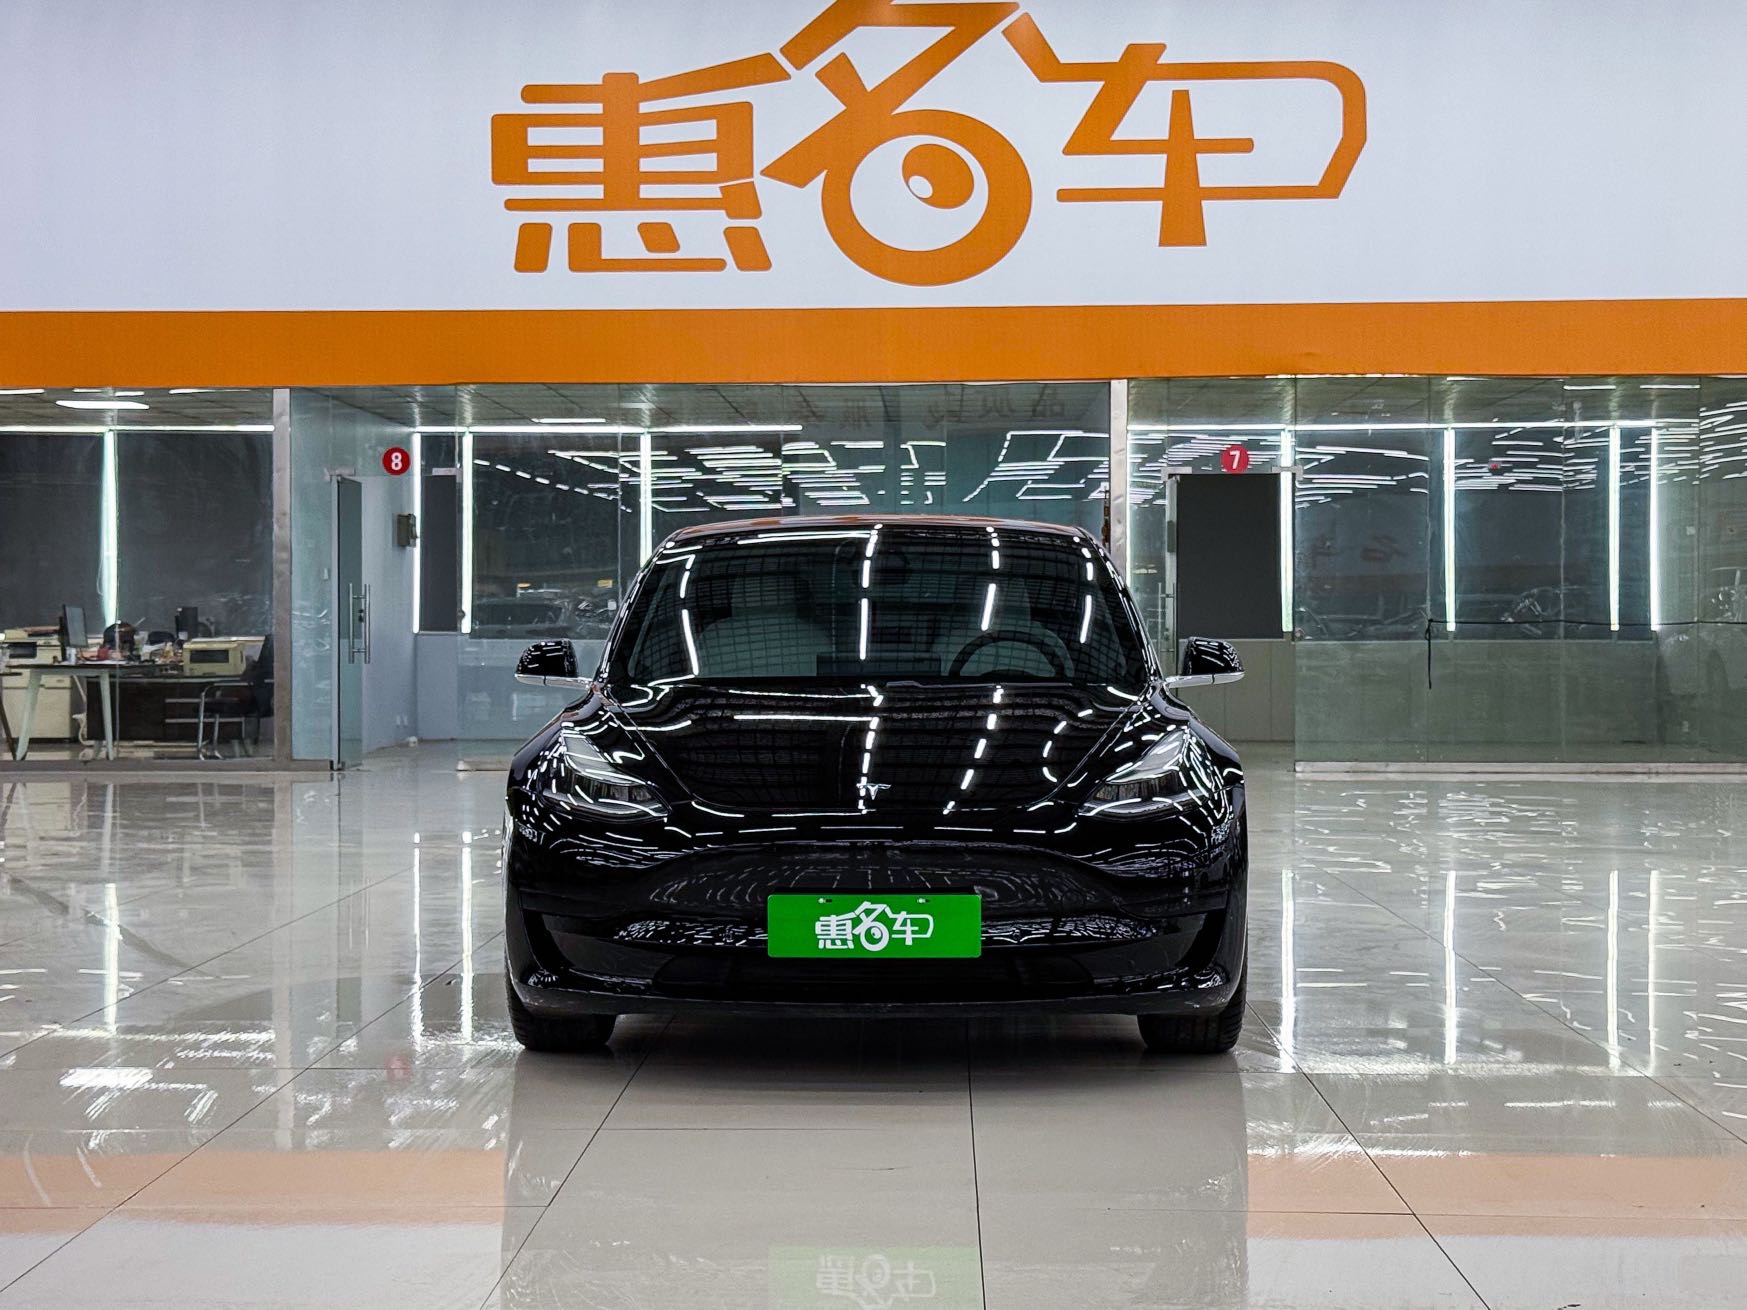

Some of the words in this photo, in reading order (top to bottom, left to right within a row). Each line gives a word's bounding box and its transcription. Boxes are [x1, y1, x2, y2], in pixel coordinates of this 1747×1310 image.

[391, 452, 402, 471] 8
[1229, 450, 1241, 470] 7
[814, 901, 934, 952] 惠名车
